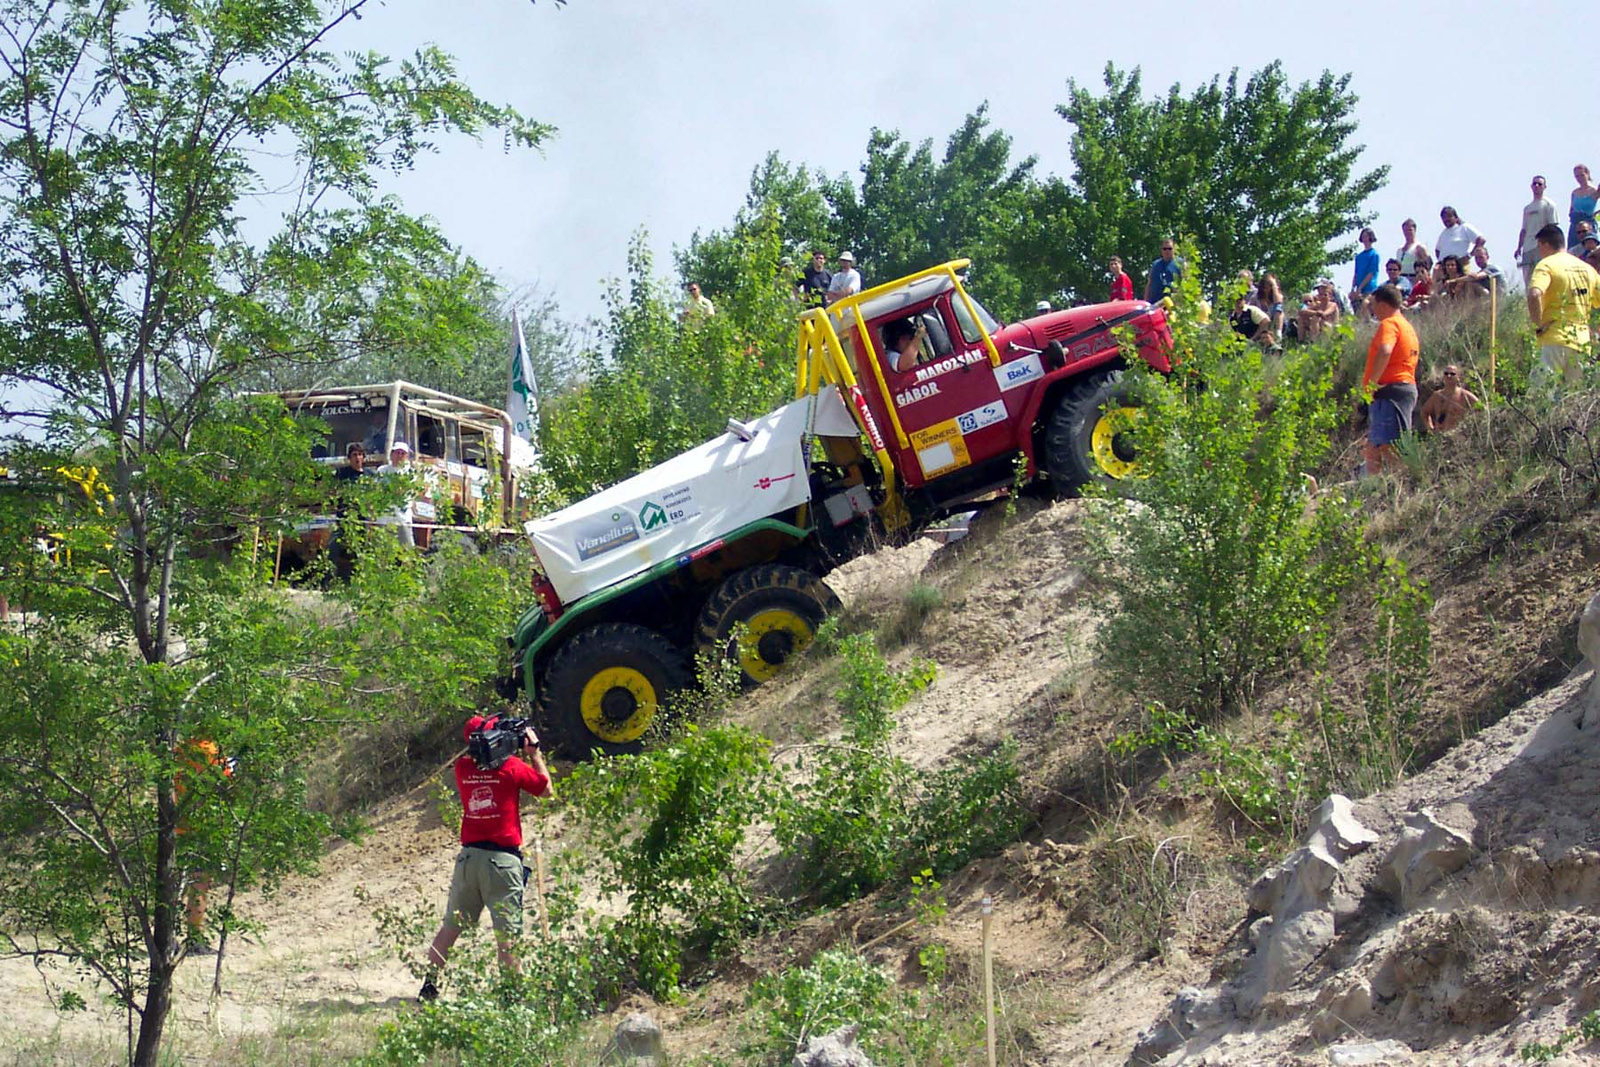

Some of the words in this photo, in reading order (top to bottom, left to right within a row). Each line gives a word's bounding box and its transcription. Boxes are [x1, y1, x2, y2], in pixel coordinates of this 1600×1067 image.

[915, 348, 984, 382] MAROZSÁN
[1007, 364, 1032, 381] B&K
[896, 381, 941, 407] GÁBOR
[861, 404, 884, 448] KUMHO
[912, 429, 929, 442] FOR
[922, 426, 958, 445] WINNERS
[577, 522, 635, 552] Vanellus
